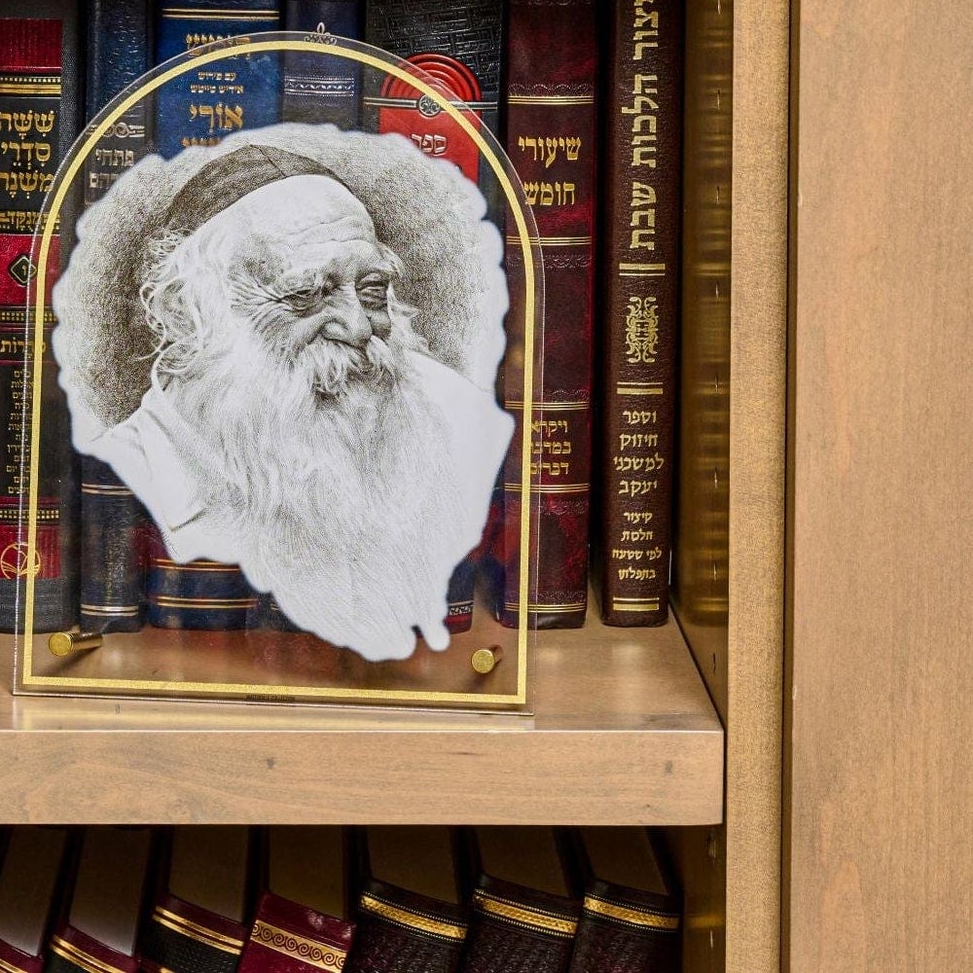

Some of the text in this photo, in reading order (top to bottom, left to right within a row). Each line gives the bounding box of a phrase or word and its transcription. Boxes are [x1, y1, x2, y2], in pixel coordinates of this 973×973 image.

[621, 73, 659, 169] הלכות
[411, 132, 447, 156] ספר
[517, 136, 582, 169] שיעורי
[524, 181, 576, 207] חומש
[629, 181, 657, 251] שבת
[622, 409, 657, 425] וספר
[619, 432, 658, 451] חיזוק
[613, 453, 665, 472] למשכני
[618, 481, 658, 498] יעקב
[623, 511, 653, 525] קיצור
